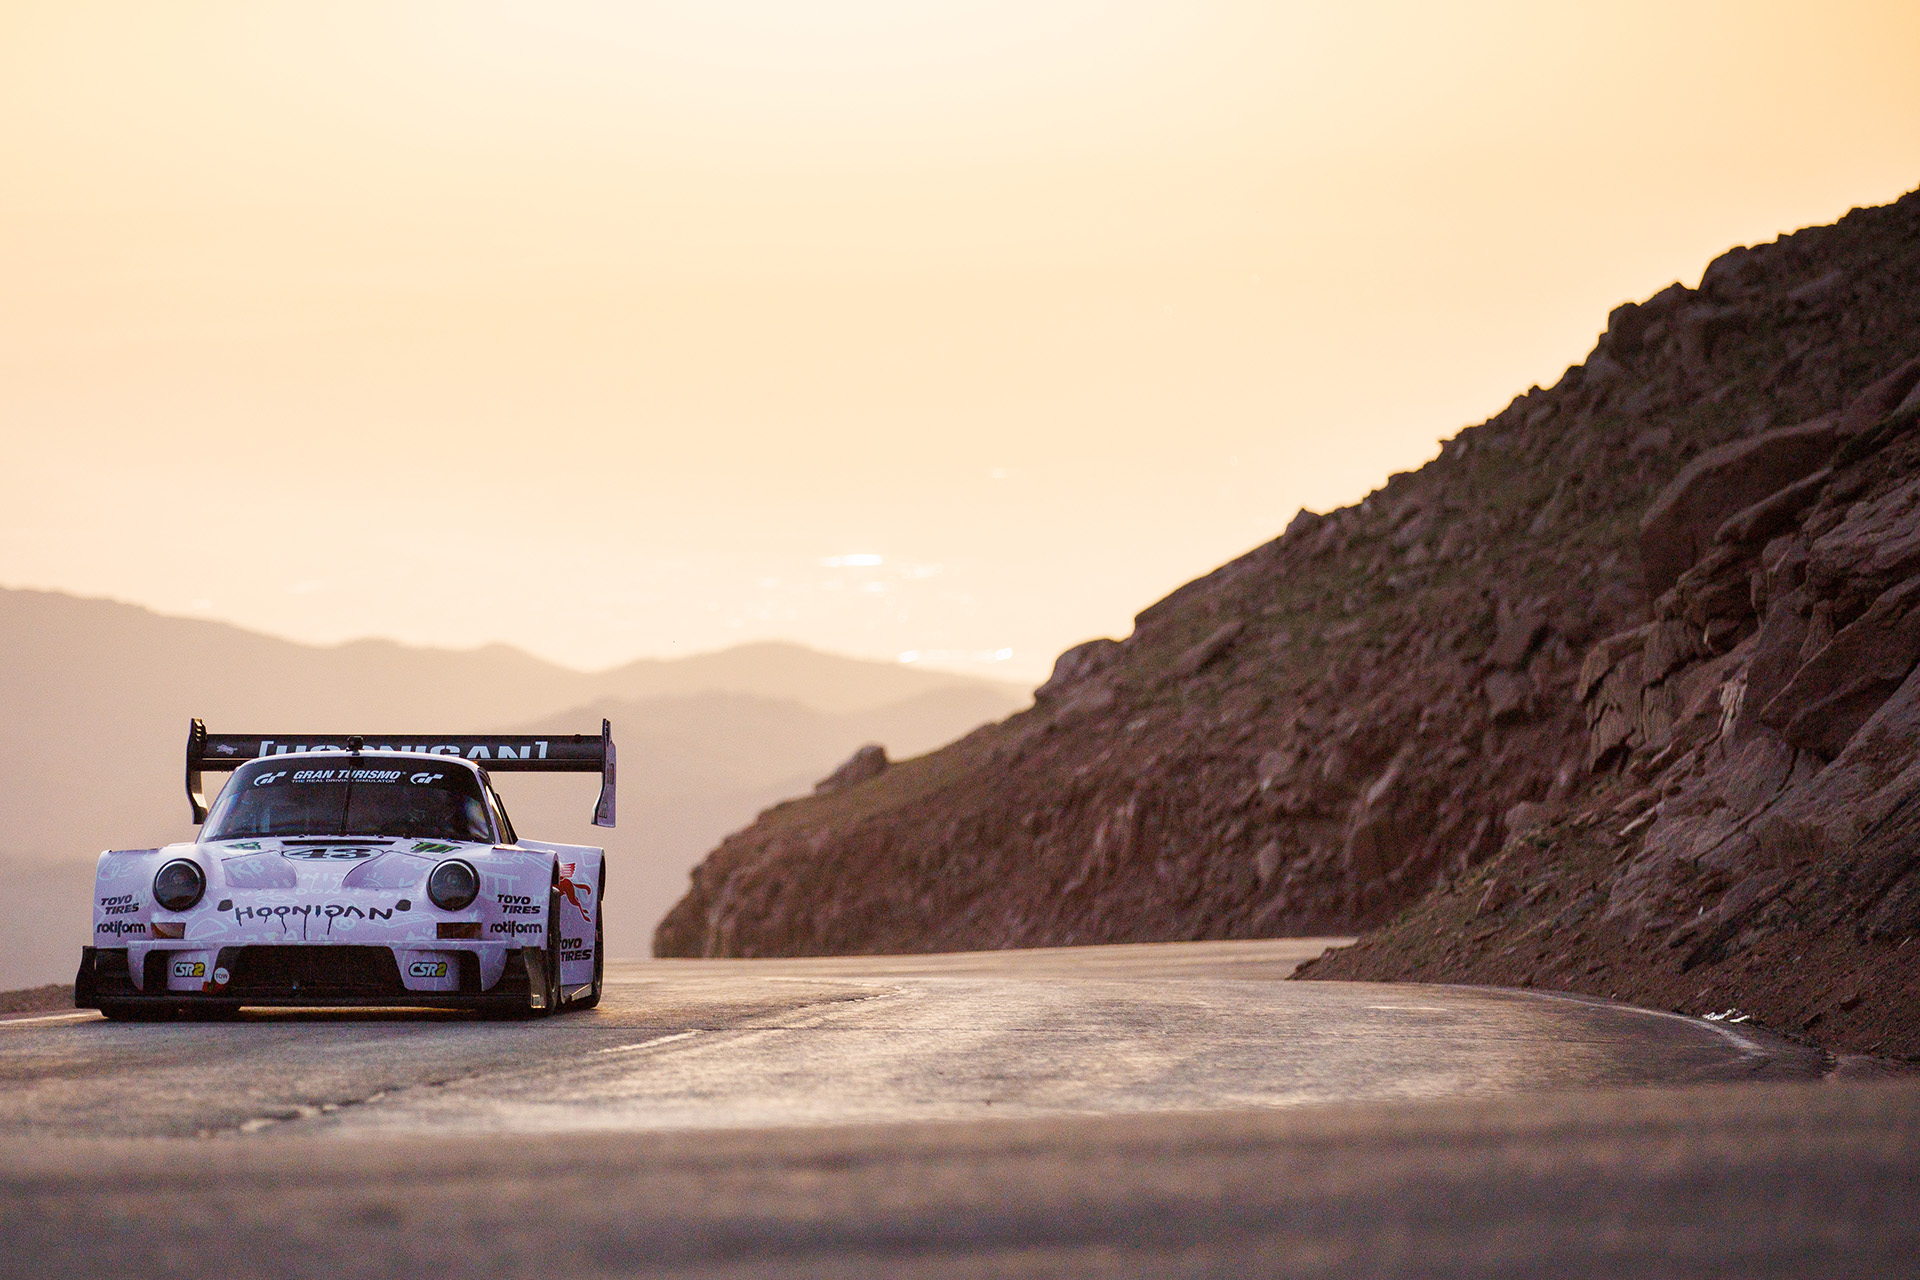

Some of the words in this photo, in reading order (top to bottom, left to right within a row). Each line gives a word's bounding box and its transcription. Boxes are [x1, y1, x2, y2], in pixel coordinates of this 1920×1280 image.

[293, 770, 335, 779] GRAN
[339, 770, 401, 779] TURISMO
[289, 848, 372, 859] 43
[101, 894, 133, 906] TOYO
[497, 894, 531, 904] TOYO
[105, 902, 139, 915] TIRES
[502, 904, 541, 914] TIRES
[235, 904, 393, 933] HOONIGAN
[97, 920, 146, 937] rotiform
[490, 921, 542, 937] rotiform
[560, 937, 583, 949] OYO
[561, 949, 592, 961] TIRES
[174, 962, 205, 977] CSR2
[409, 962, 447, 977] CSR2
